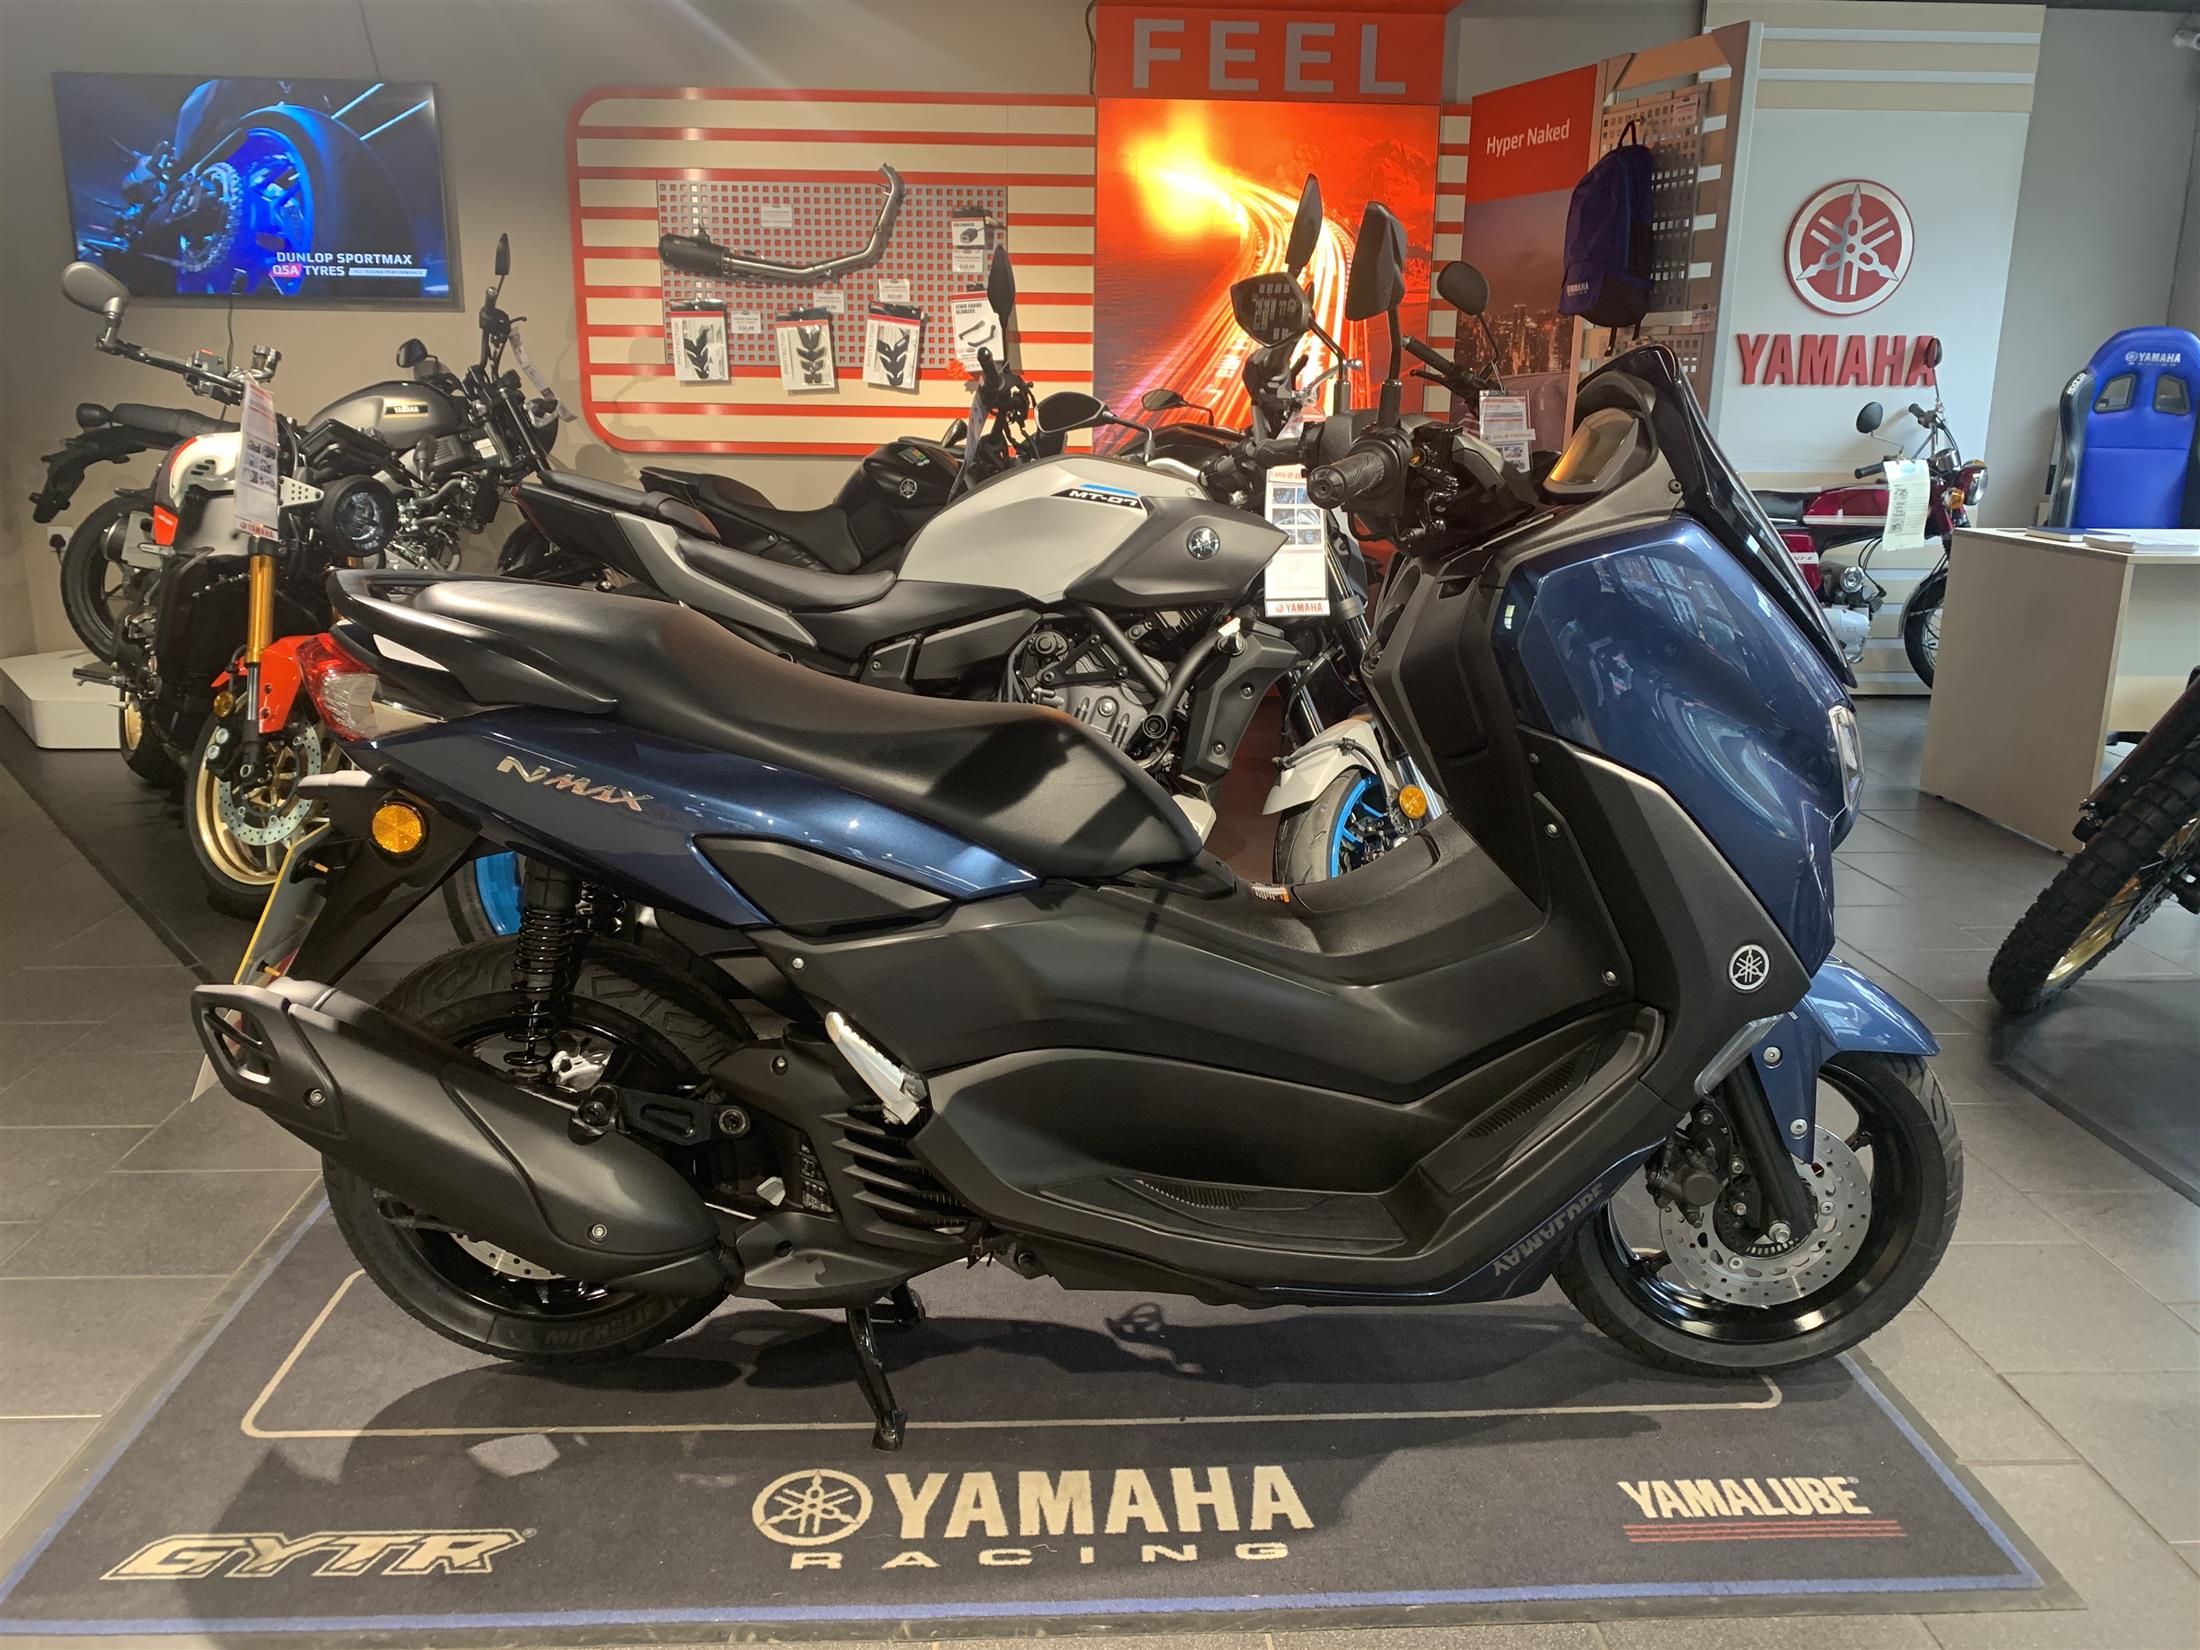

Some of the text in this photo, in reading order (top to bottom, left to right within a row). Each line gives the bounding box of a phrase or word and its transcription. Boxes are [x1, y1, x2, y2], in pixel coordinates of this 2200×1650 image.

[1132, 18, 1407, 95] FEEL
[1486, 118, 1571, 158] Hyper Naked
[276, 252, 413, 265] DUNLOP SPORTMAX
[303, 265, 345, 276] TYRES
[1736, 333, 1936, 386] YAMAHA
[2139, 353, 2182, 363] YAMAHA
[1068, 490, 1138, 506] MT-07
[246, 524, 274, 539] YAMAHA
[1285, 602, 1323, 614] YAMAHA
[496, 755, 654, 812] NMAX
[885, 1465, 1315, 1540] YAMAHA
[1617, 1476, 1873, 1519] YAMALUBE
[101, 1529, 526, 1580] GYTR
[790, 1541, 1289, 1570] RACING
